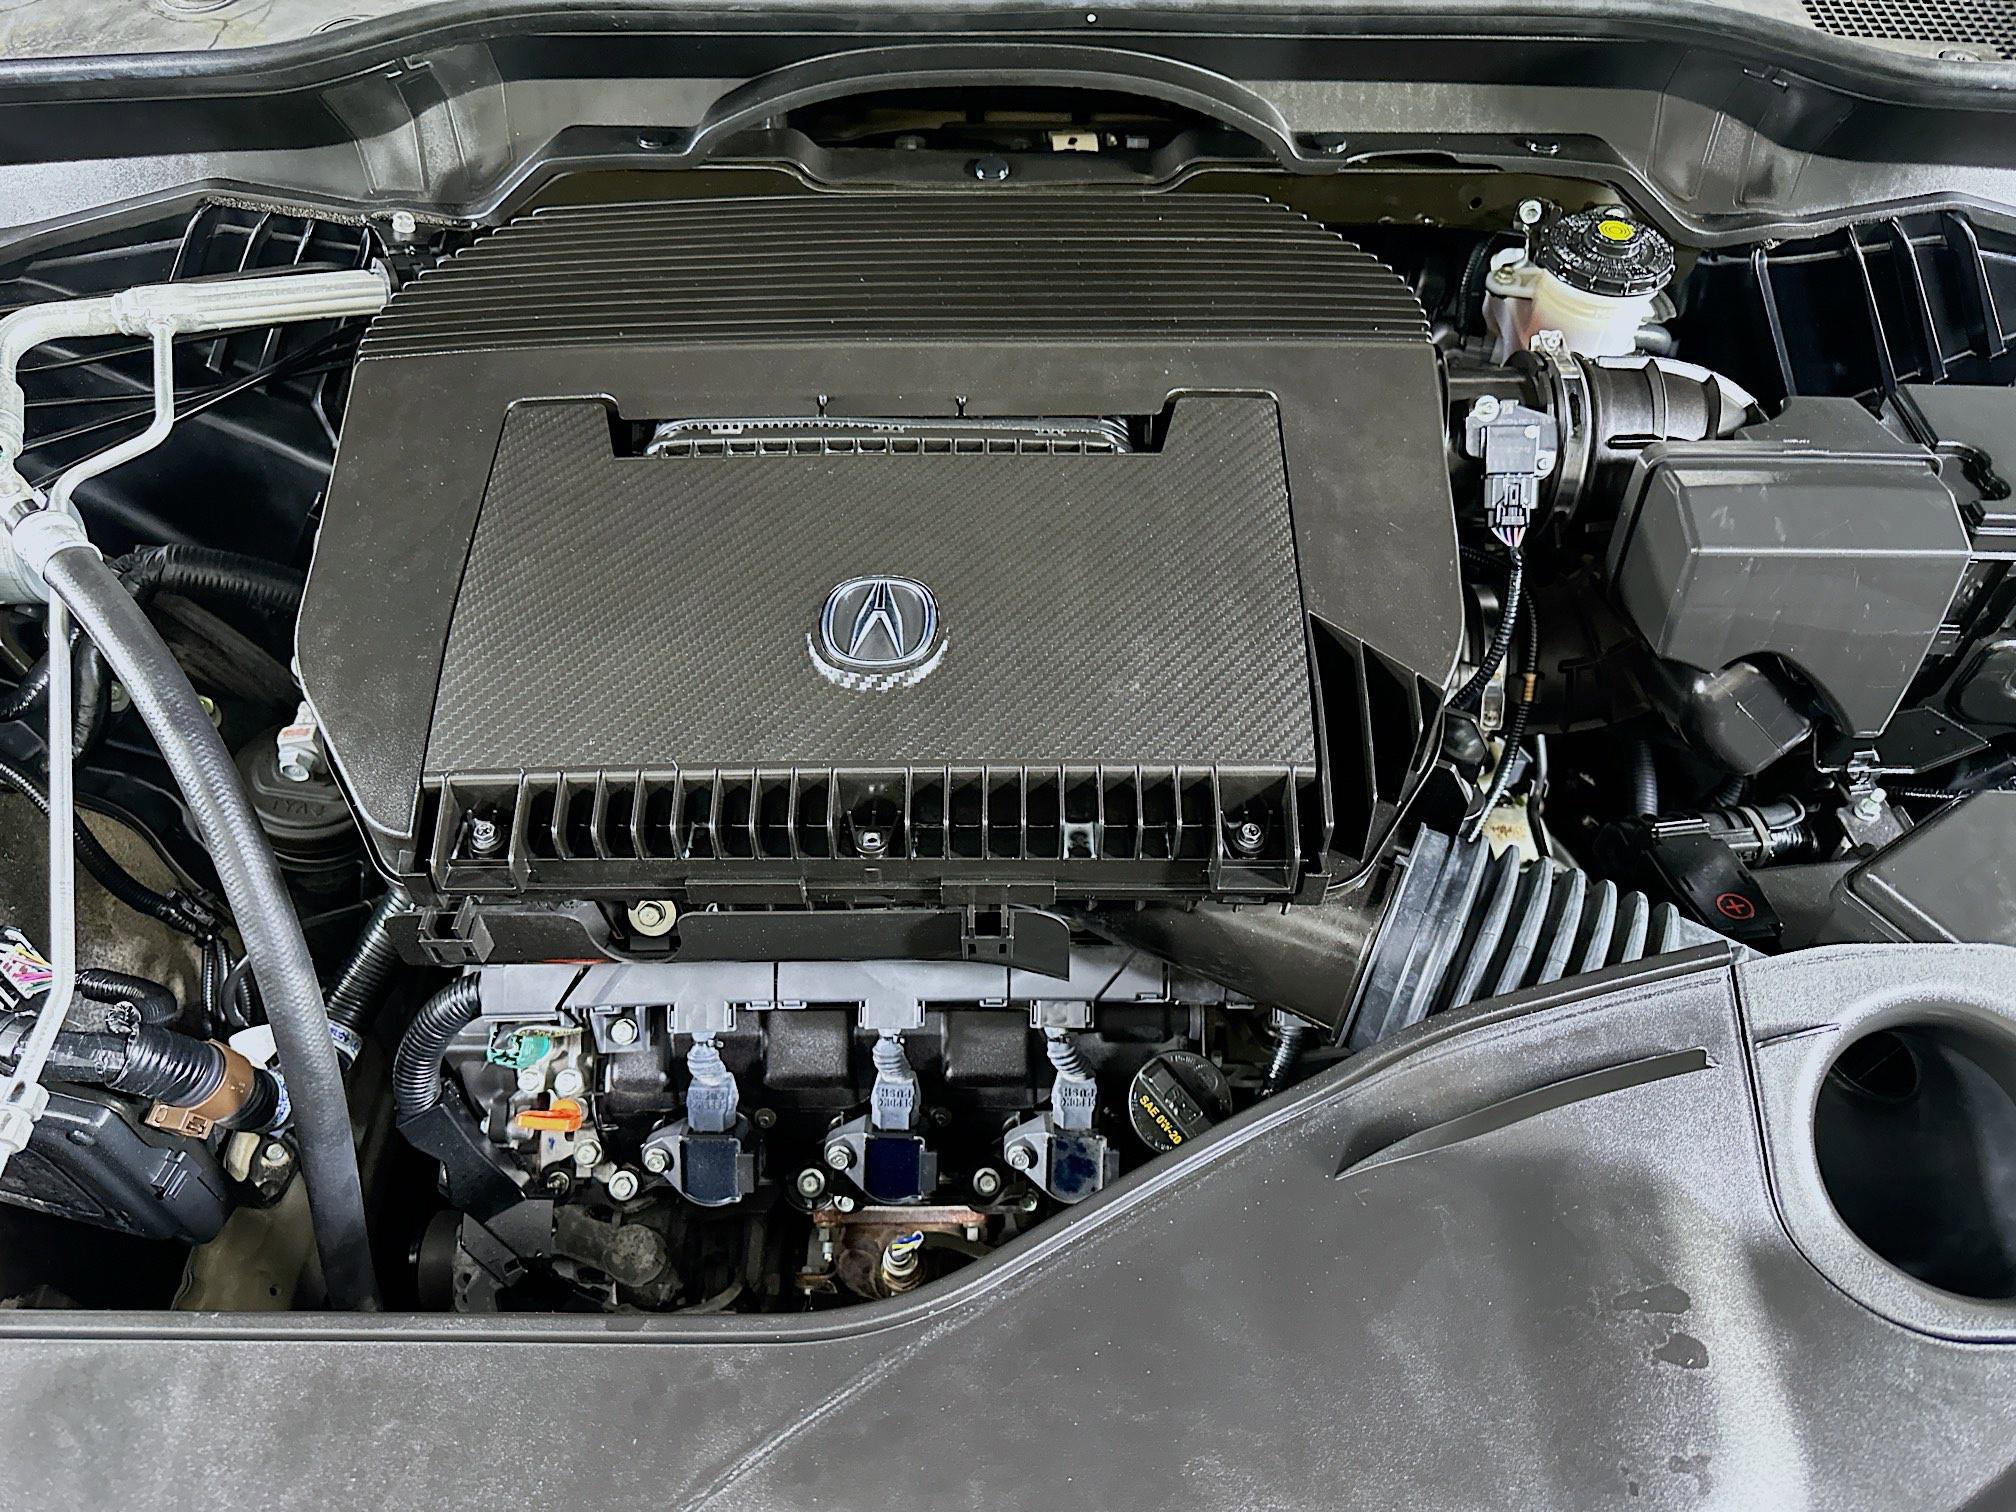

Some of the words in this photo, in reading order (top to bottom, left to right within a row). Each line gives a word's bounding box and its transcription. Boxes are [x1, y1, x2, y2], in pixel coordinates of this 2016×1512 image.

[882, 1088, 911, 1098] PUSH
[1065, 1087, 1095, 1097] PUSH
[1139, 1095, 1160, 1118] SAE
[1156, 1114, 1182, 1145] 0W-20
